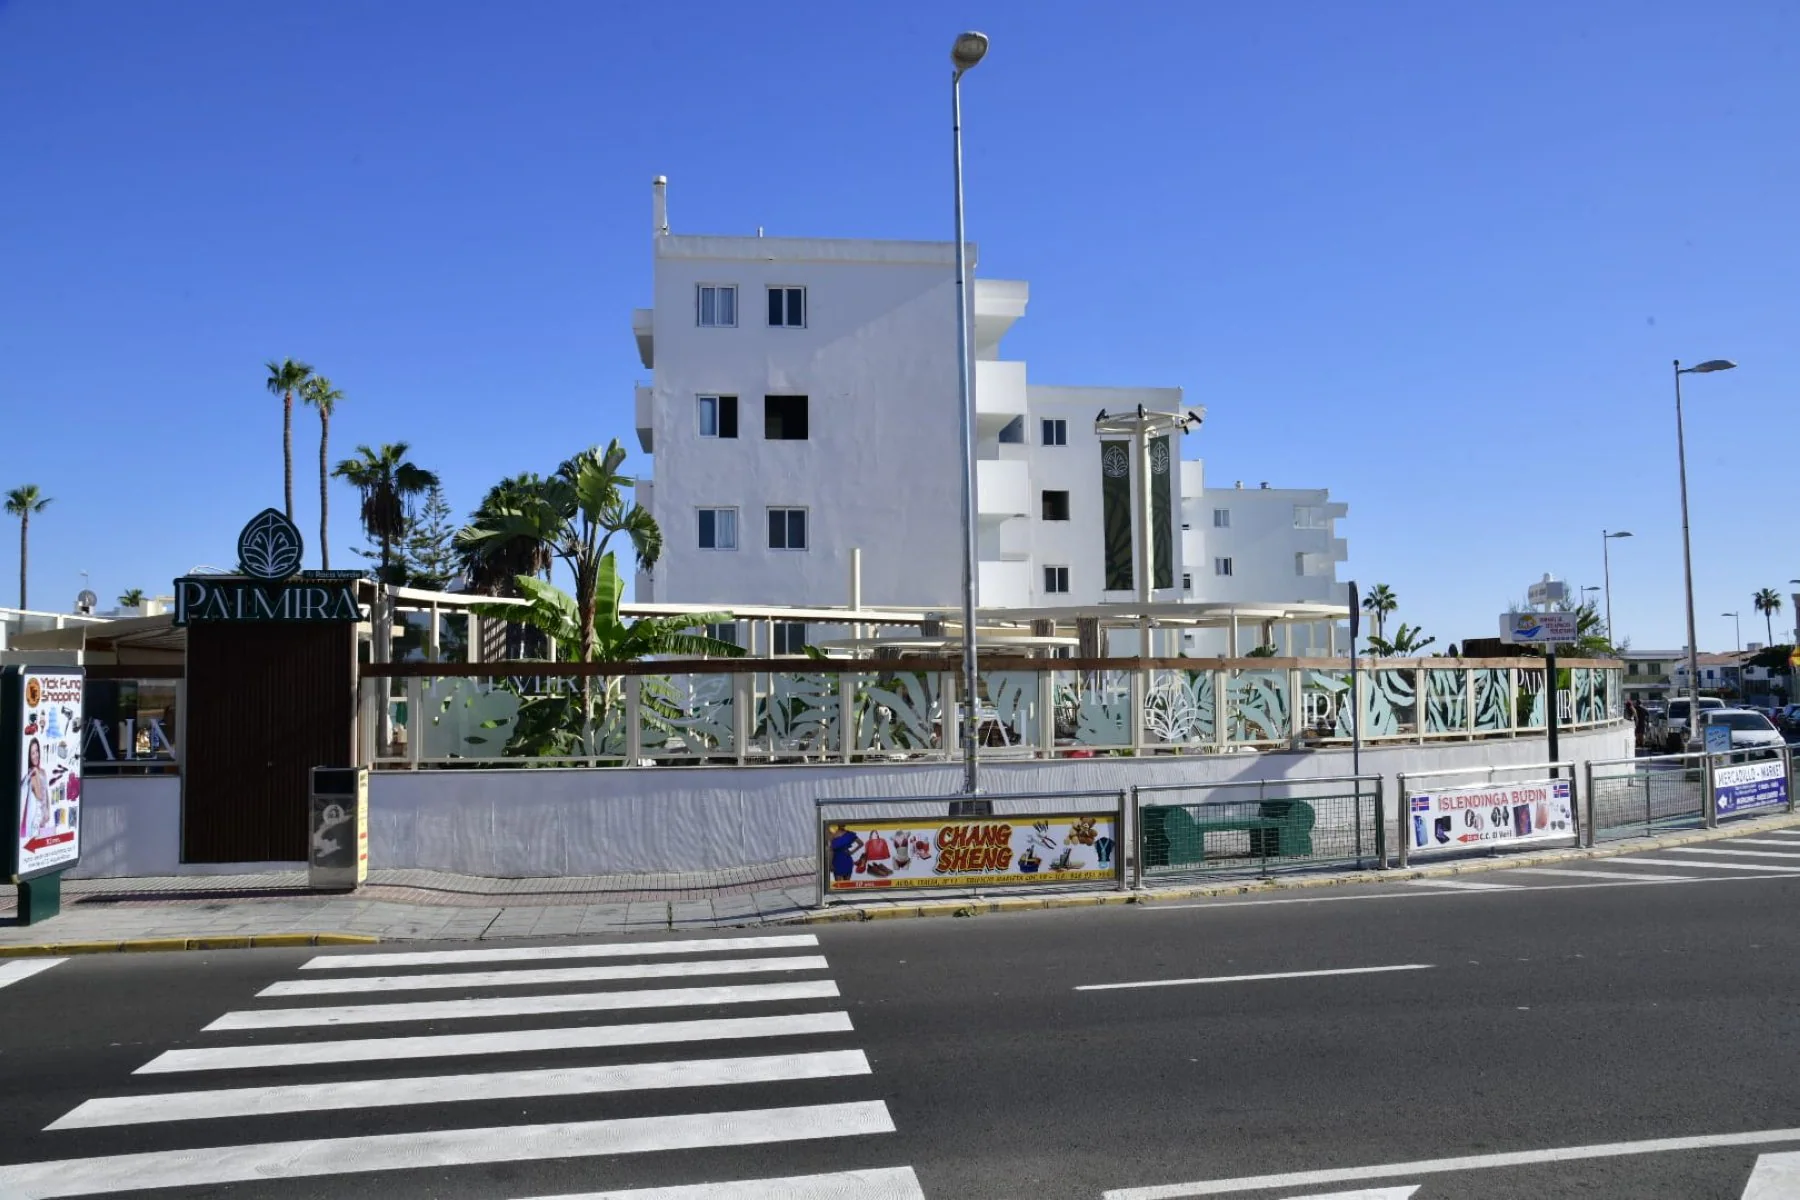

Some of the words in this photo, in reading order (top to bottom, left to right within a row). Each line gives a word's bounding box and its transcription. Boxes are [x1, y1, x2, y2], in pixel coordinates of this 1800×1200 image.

[177, 581, 360, 624] PALMIRA
[41, 690, 80, 704] Shopping
[938, 823, 1013, 849] CHANG
[936, 847, 1014, 873] SHENG
